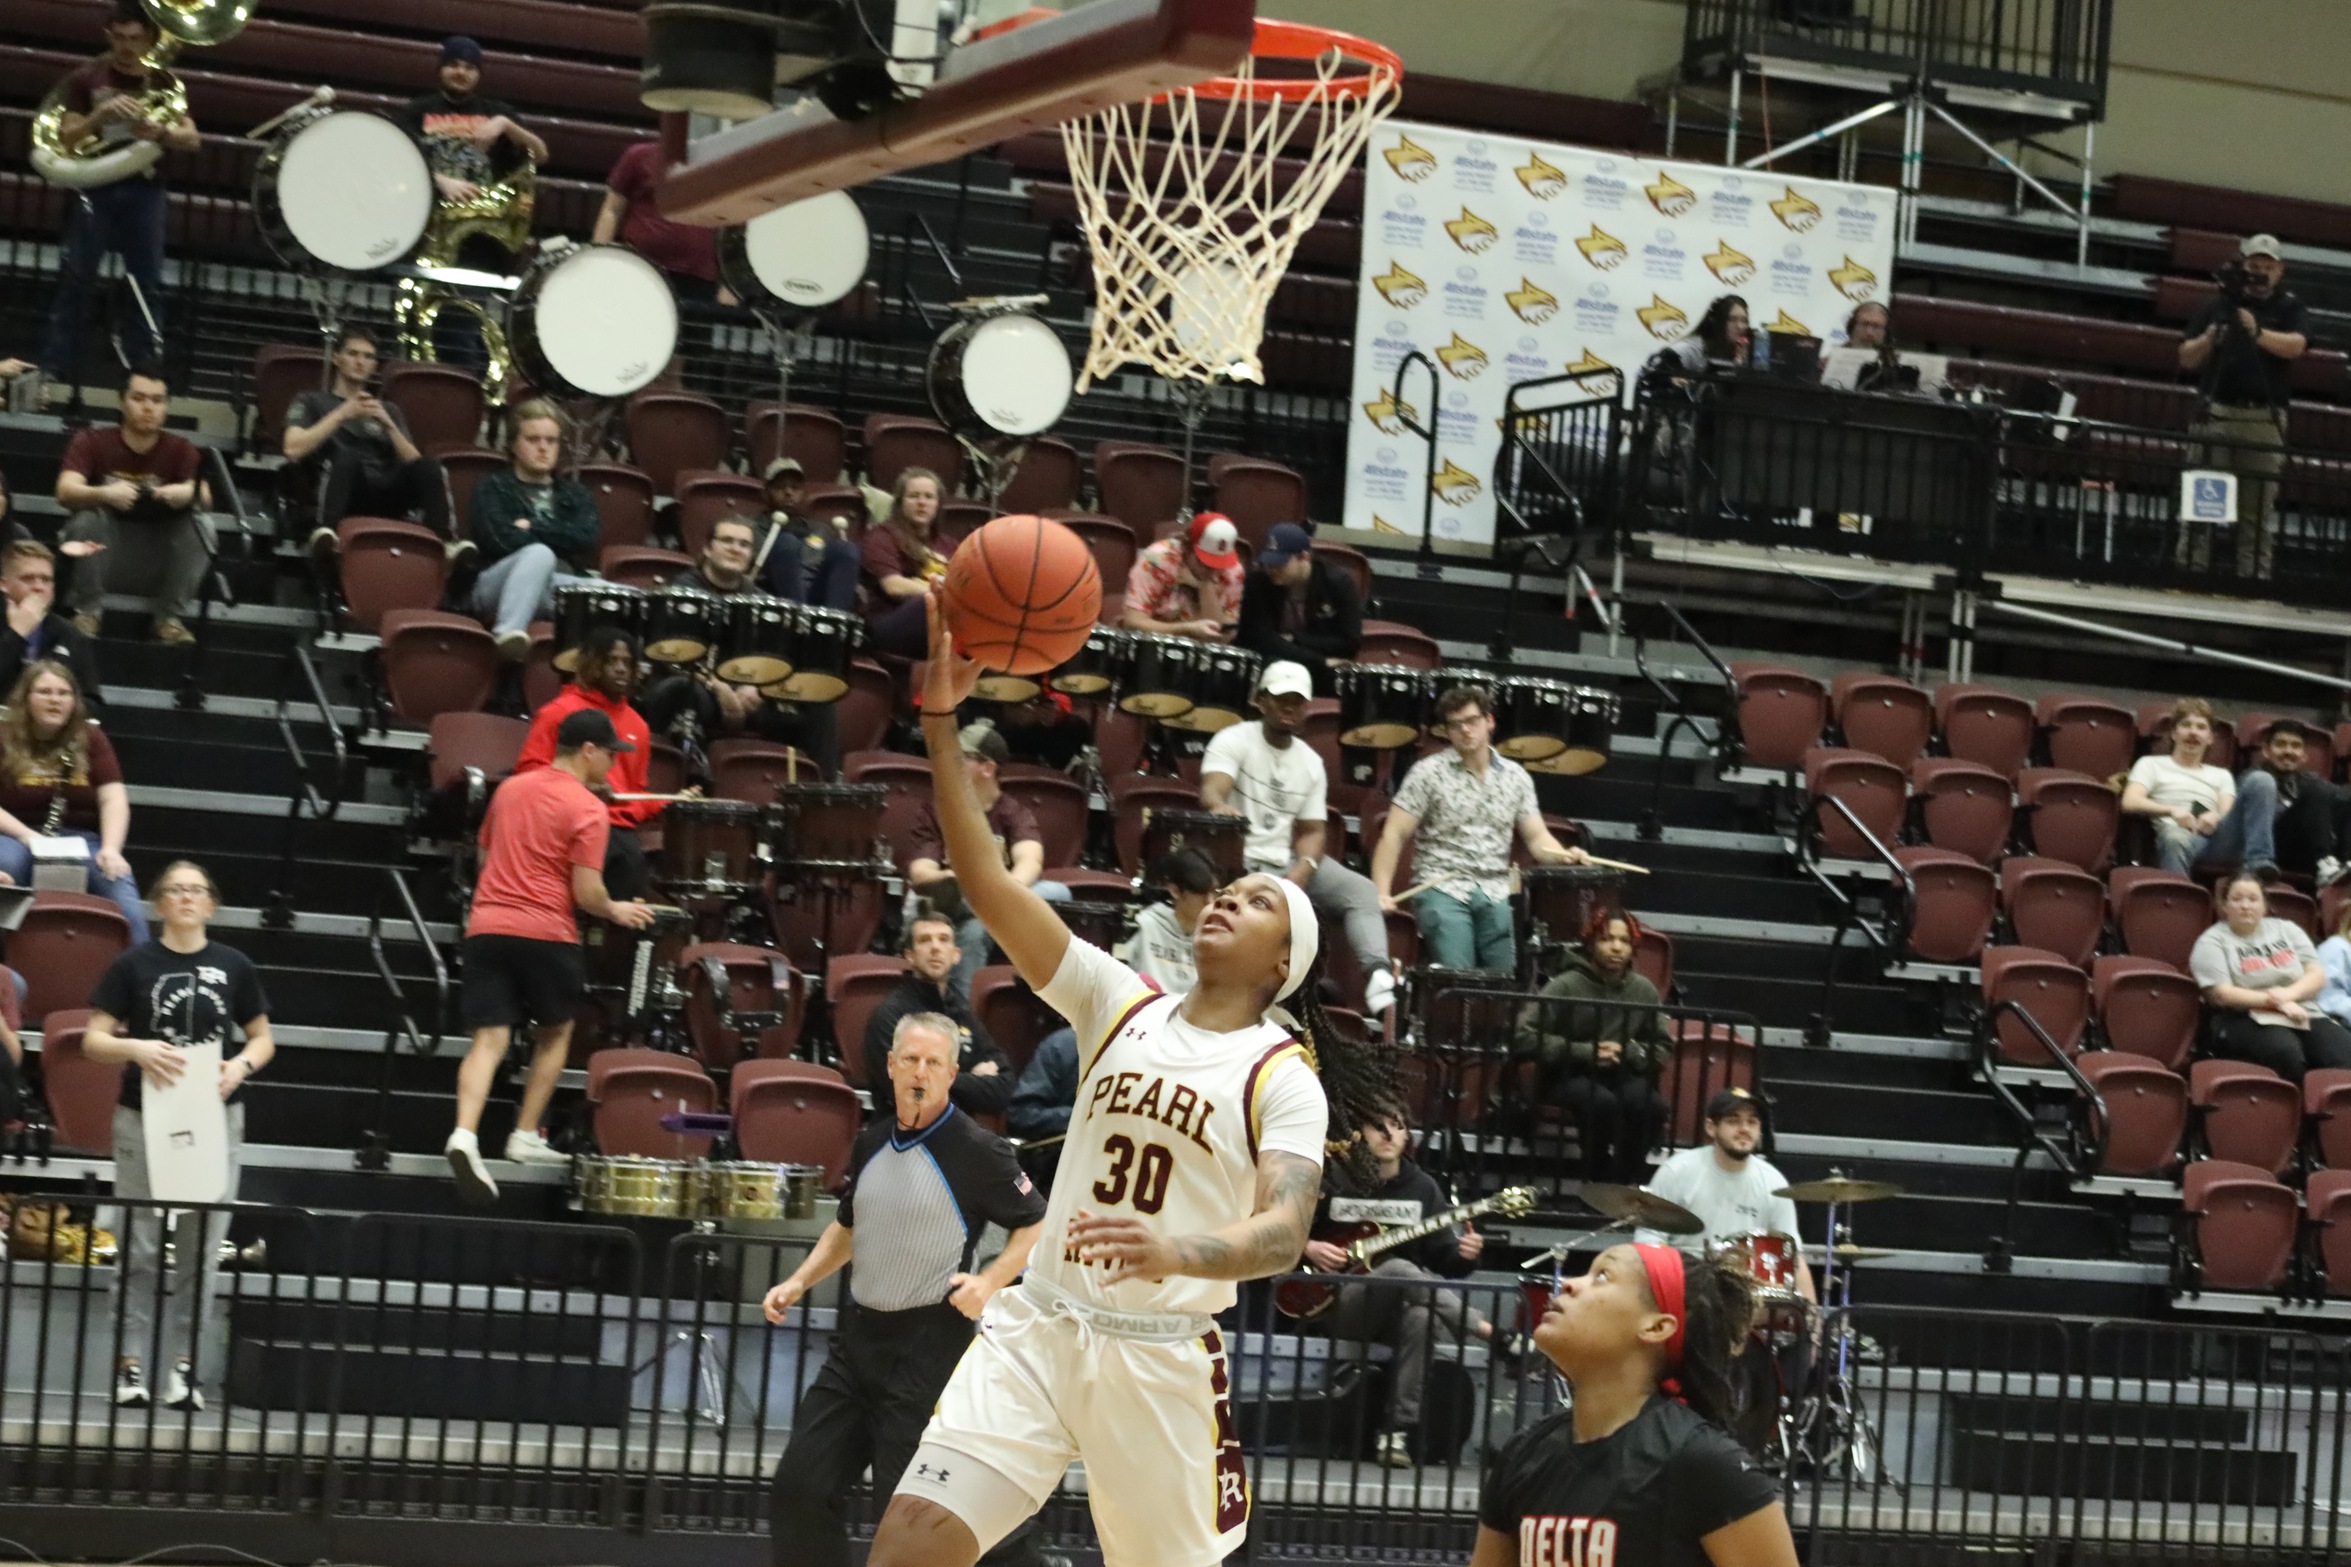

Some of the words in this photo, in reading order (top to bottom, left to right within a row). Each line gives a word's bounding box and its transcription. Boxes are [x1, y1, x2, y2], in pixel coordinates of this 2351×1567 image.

[1086, 1071, 1217, 1157] PEARL
[1092, 1132, 1174, 1216] 30
[1520, 1514, 1619, 1567] DELTA
